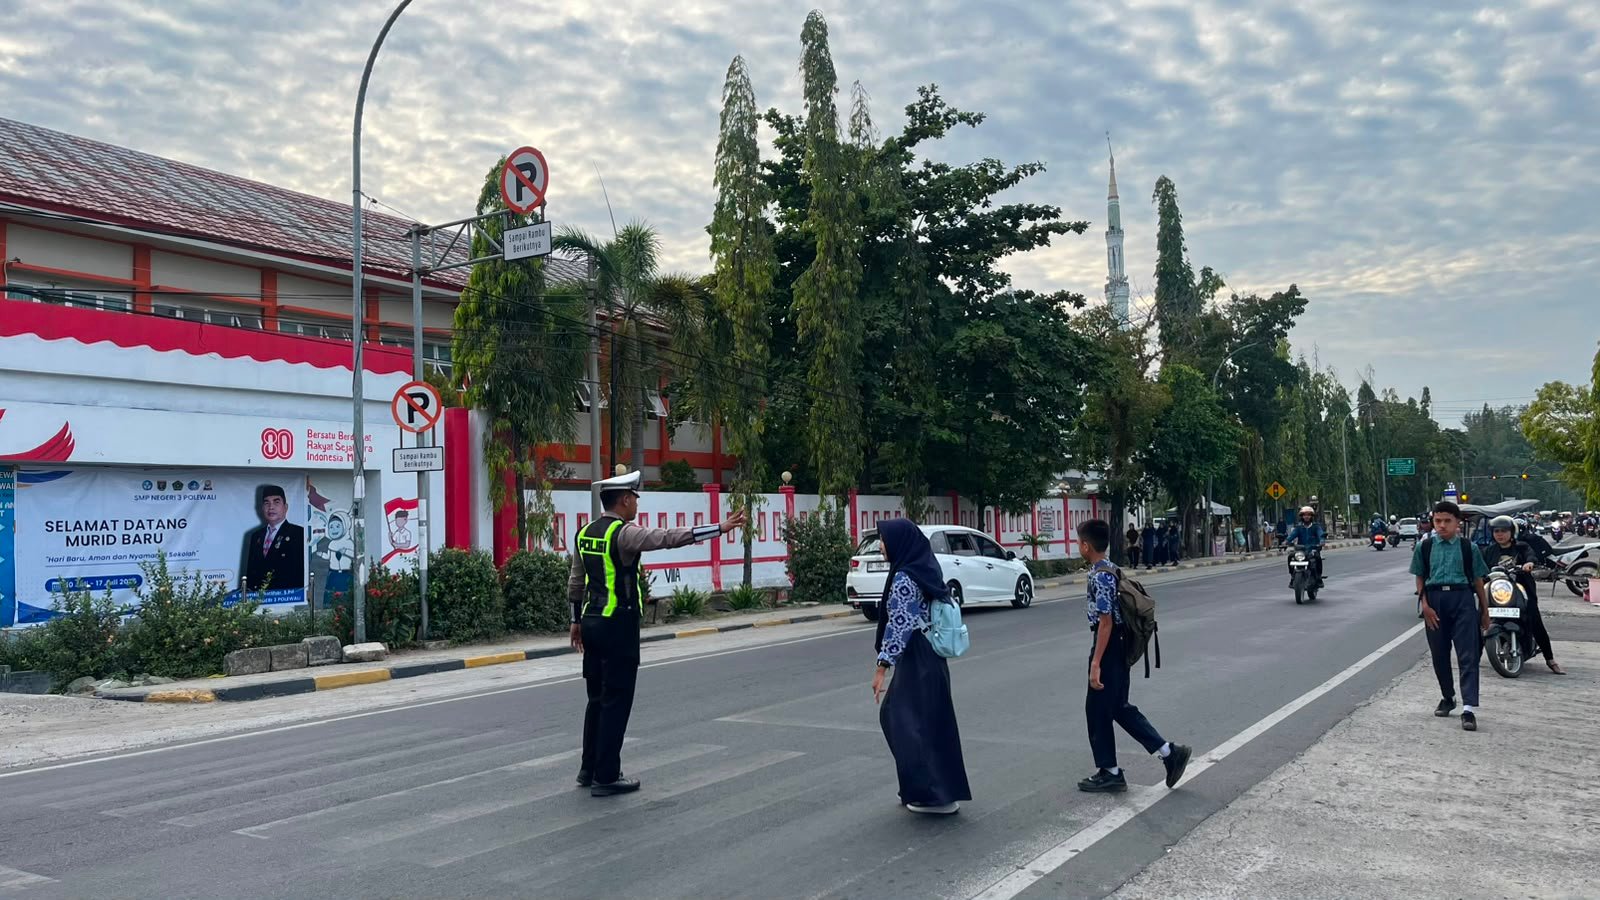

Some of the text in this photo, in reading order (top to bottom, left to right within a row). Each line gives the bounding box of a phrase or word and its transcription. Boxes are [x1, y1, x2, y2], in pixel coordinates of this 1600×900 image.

[516, 162, 537, 202] P
[508, 228, 546, 243] Sampai Rambu
[513, 243, 541, 253] Berikutnya
[407, 392, 430, 424] P
[306, 429, 336, 440] Bersatu
[261, 428, 293, 460] 80
[306, 441, 335, 454] Rakyat
[306, 451, 344, 462] Indonesia
[45, 518, 188, 533] SELAMAT DATANG
[65, 533, 164, 548] MURID BARU
[580, 539, 606, 553] POLISI
[88, 554, 110, 562] Aman
[112, 553, 128, 561] dan
